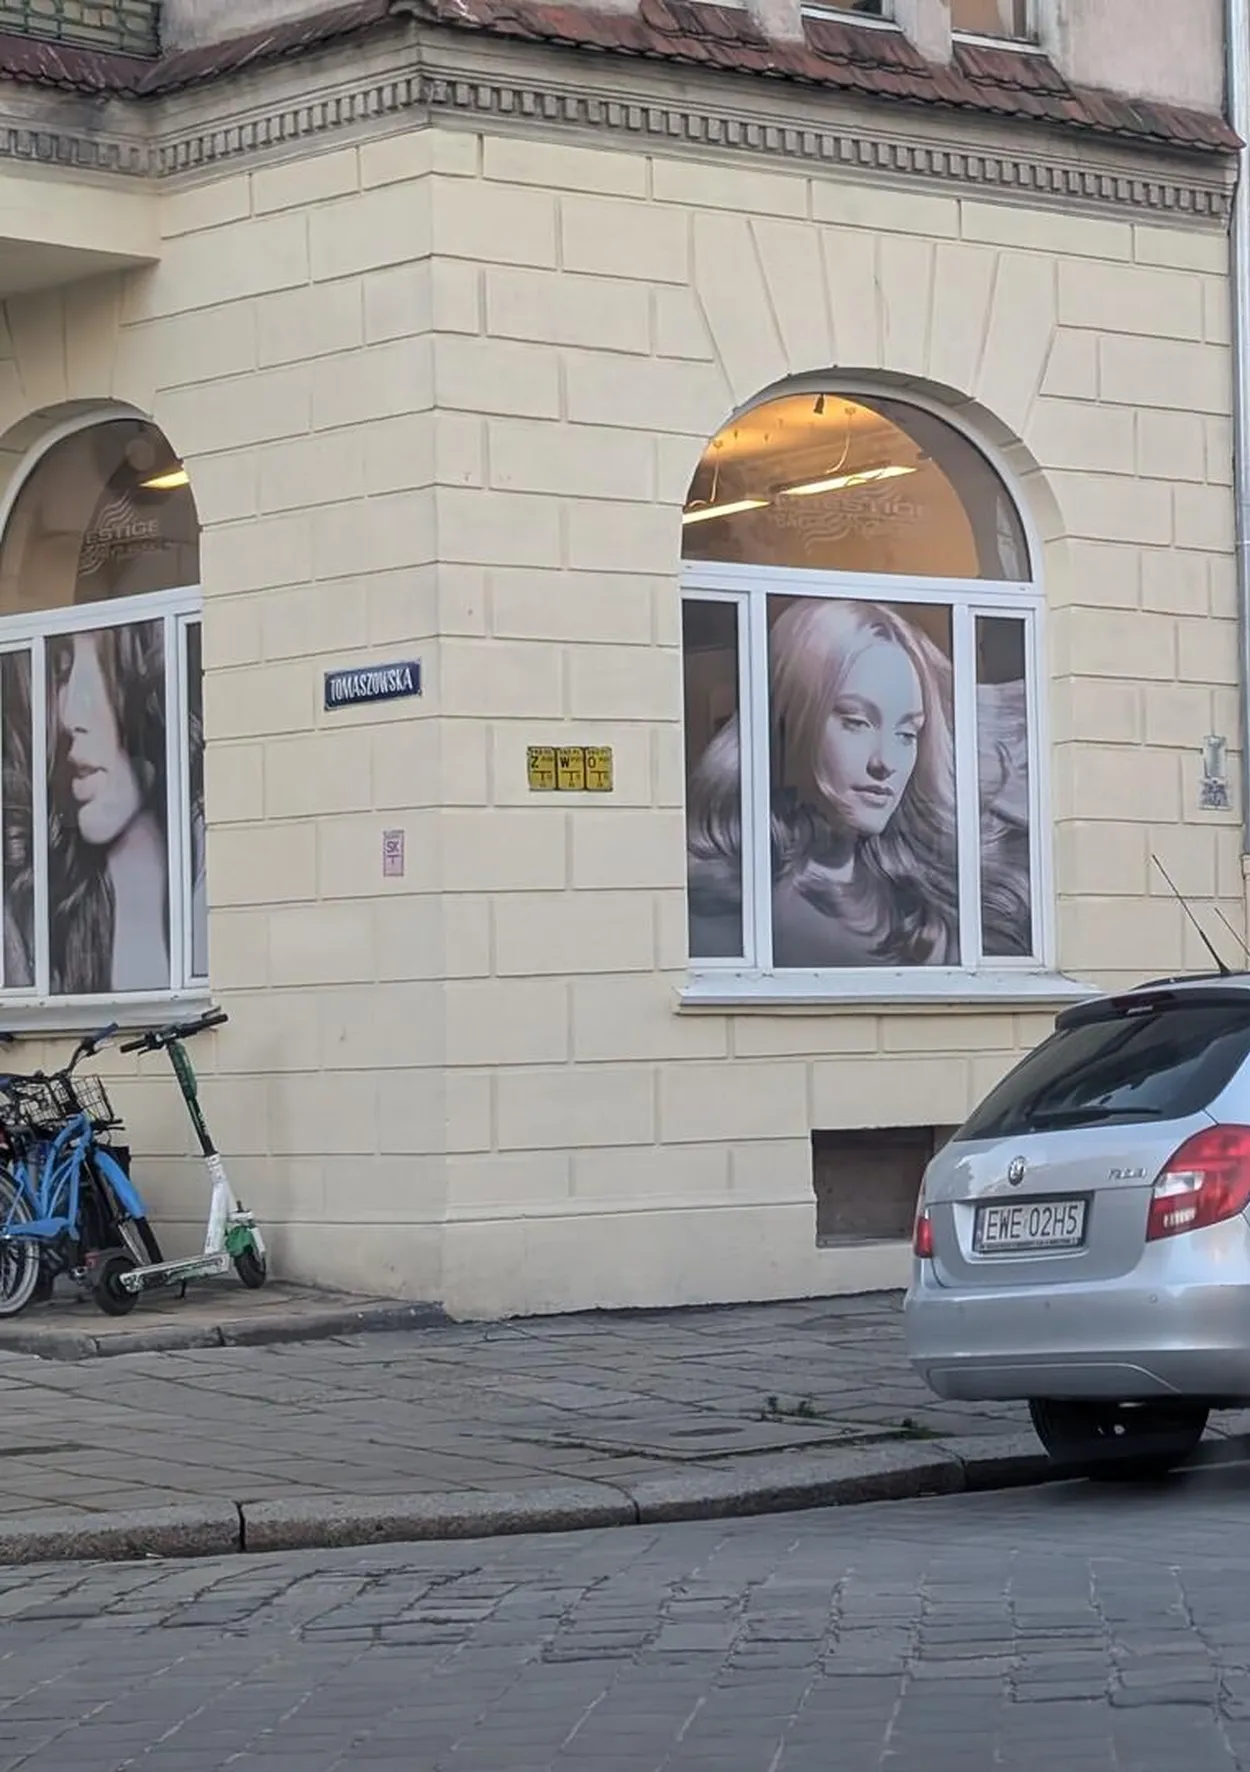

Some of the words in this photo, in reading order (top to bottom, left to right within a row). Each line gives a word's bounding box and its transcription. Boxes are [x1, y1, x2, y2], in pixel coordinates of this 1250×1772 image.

[330, 667, 413, 701] TOMASZOWSKA
[531, 756, 539, 768] Z
[560, 756, 570, 768] W
[986, 1207, 1023, 1240] EWE
[1029, 1204, 1078, 1237] 02H5
